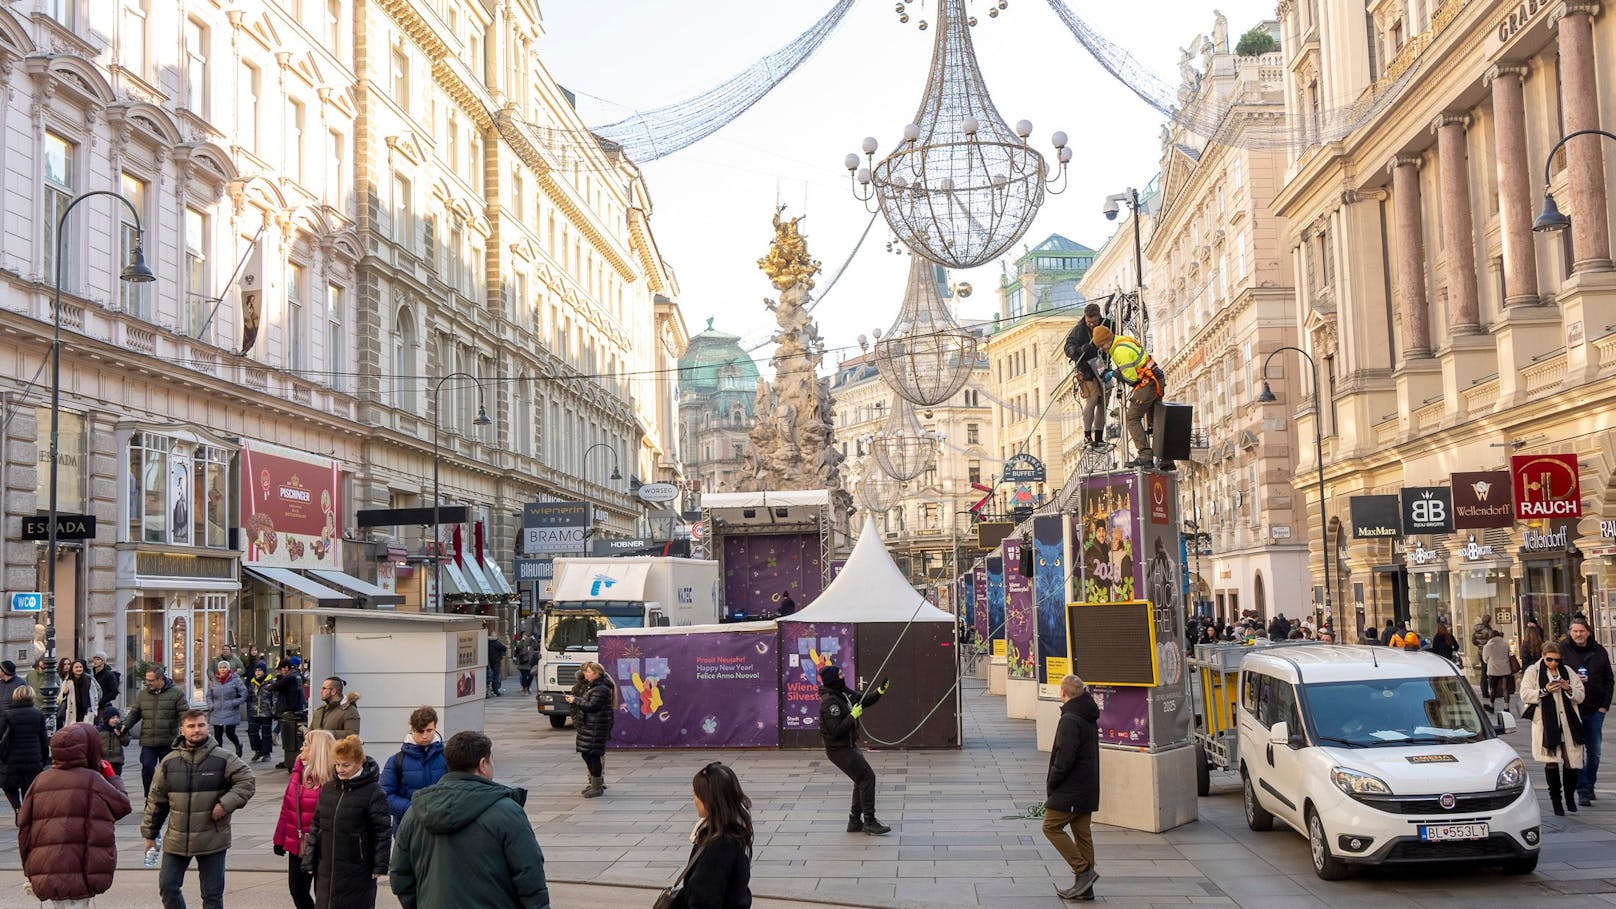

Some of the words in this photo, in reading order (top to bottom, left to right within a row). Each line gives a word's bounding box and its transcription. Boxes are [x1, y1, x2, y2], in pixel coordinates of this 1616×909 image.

[1499, 0, 1549, 42] GRAB
[39, 450, 77, 467] ESADA
[280, 487, 310, 502] PISCHINGER
[529, 505, 585, 515] wienerin
[1456, 503, 1510, 517] Wellendorff
[1520, 500, 1578, 515] RAUCH
[27, 522, 87, 535] ESADA
[1358, 526, 1396, 536] MaxMara
[1523, 525, 1567, 550] Wellendorff
[610, 540, 644, 549] HÜBNER
[17, 596, 29, 607] WC
[697, 656, 716, 664] Prosit
[717, 656, 746, 664] Neujahr!
[787, 682, 819, 691] Wiene
[787, 692, 821, 700] Silvest
[1428, 828, 1443, 838] BL
[1450, 825, 1487, 837] 553LY
